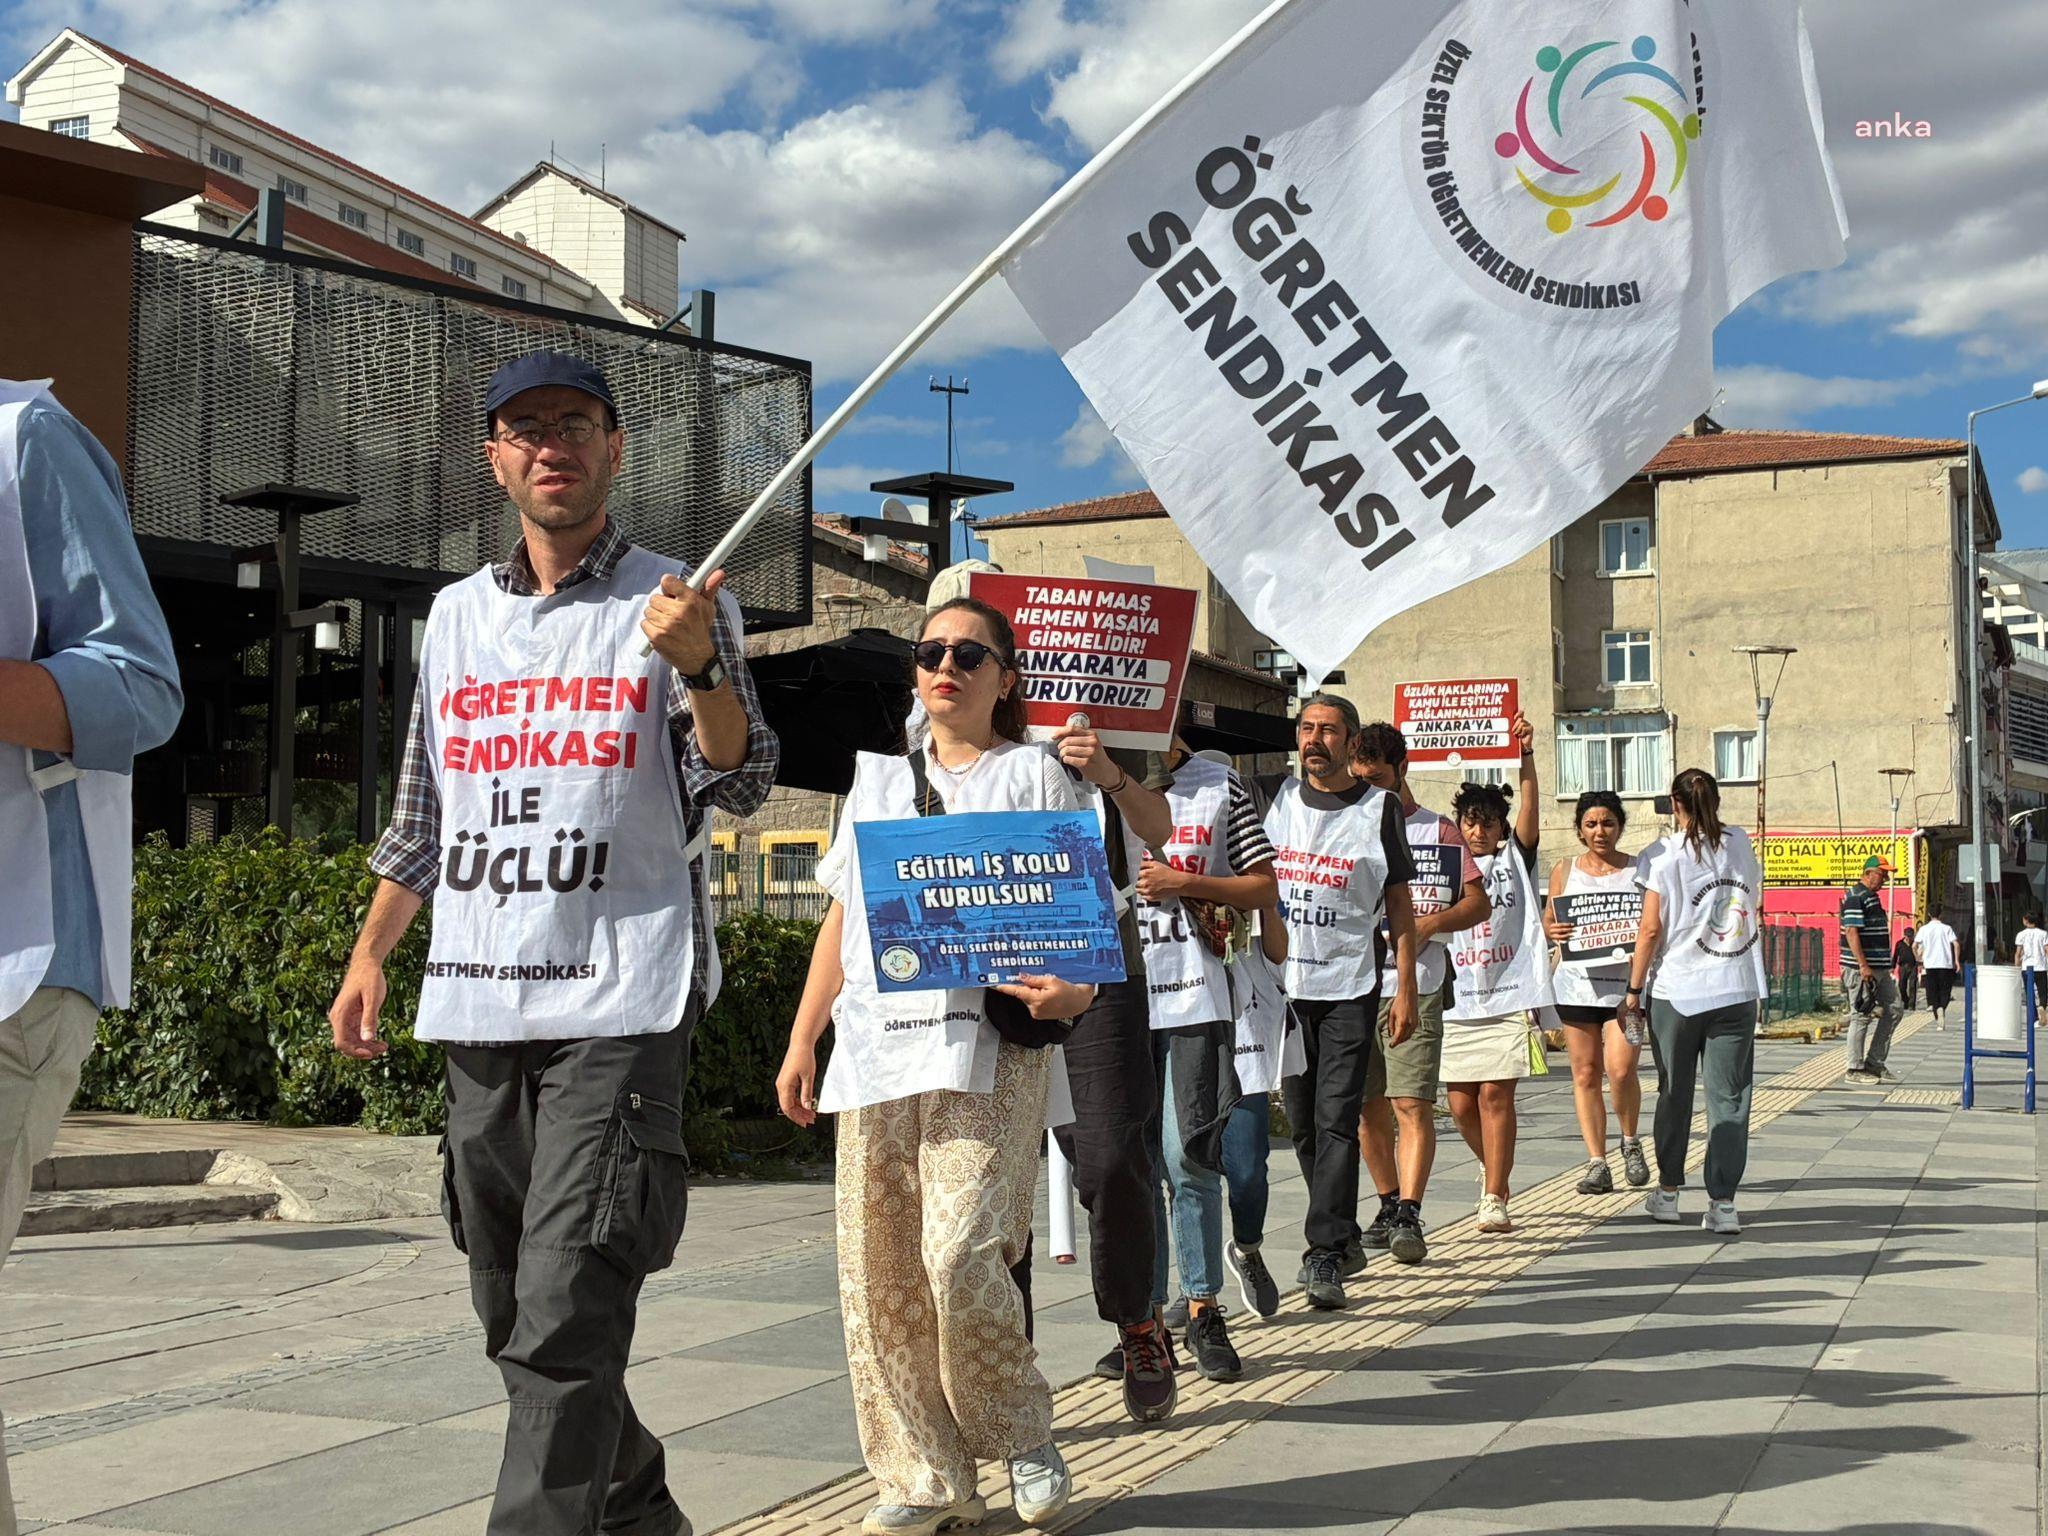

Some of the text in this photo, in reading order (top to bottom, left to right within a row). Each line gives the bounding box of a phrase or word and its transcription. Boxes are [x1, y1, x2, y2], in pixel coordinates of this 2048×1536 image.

[1421, 39, 1641, 309] ÖZEL SEKTÖR ÖĞRETMENLERİ SENDİKASI
[1196, 135, 1496, 528] ÖĞRETMEN
[1127, 211, 1417, 571] SENDİKASI
[1026, 586, 1152, 614] TABAN MAAŞ
[1014, 607, 1160, 635] HEMEN YASAYA
[1028, 625, 1147, 655] GİRMELİDİR!
[1017, 651, 1147, 679] ANKARA'YA
[1023, 675, 1152, 708] ÜRÜYORUZ!
[1403, 682, 1509, 697] ÖZLÜK HAKLARINDA
[1408, 693, 1504, 709] KAMU İLE EŞİTLİK
[1409, 706, 1502, 720] SAĞLANMALIDIR!
[1415, 719, 1493, 733] ANKARA'YA
[443, 717, 637, 775] ENDİKASI
[490, 776, 541, 828] İLE
[1410, 847, 1440, 861] RELİ
[442, 827, 609, 909] ÜÇLÜ!
[896, 851, 1071, 883] EĞİTİM İŞ KOLU
[923, 882, 1054, 910] KURULSUN!
[1290, 883, 1313, 902] İLE
[1571, 894, 1641, 907] EĞİTİM VE GÜZ
[1285, 900, 1337, 928] ÇLÜ!
[1568, 903, 1619, 917] SANATLAR
[1577, 910, 1642, 926] KURULMALID
[1472, 920, 1492, 940] İLE
[1581, 919, 1641, 936] ANKARA'Y
[940, 937, 1089, 955] ÖZEL SEKTÖR ÖĞRETMENLERİ
[1456, 943, 1514, 969] GÜÇLÜ!
[425, 959, 597, 981] RETMEN SENDİKASI
[990, 955, 1045, 968] SENDİKASI
[1150, 976, 1205, 994] SENDİKASI
[884, 1017, 941, 1032] ÖĞRETMEN
